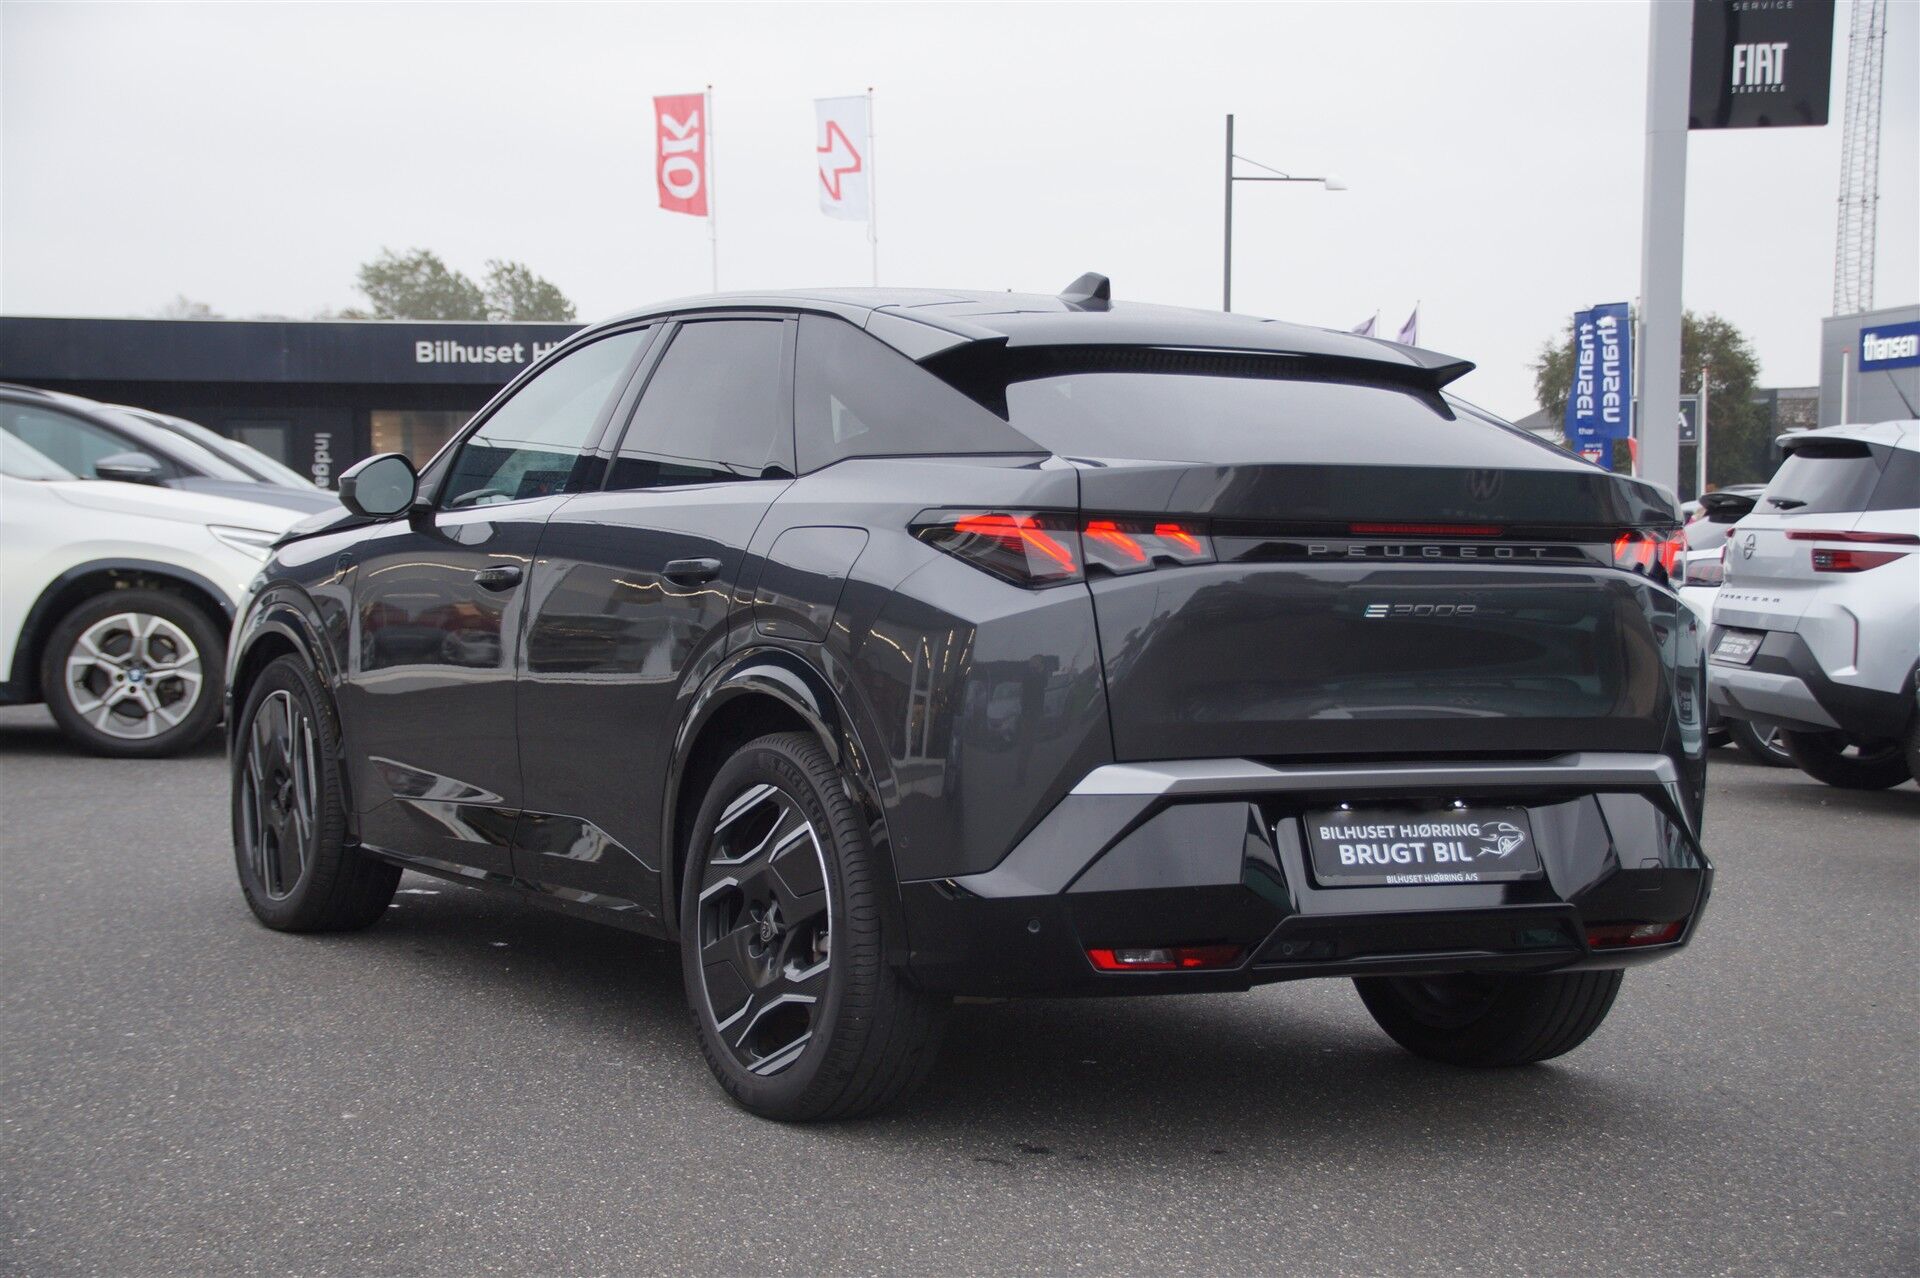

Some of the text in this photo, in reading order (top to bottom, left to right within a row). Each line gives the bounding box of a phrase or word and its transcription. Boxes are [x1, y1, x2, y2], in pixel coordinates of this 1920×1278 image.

[1733, 0, 1794, 11] SERVICE
[1732, 43, 1789, 86] FIAT
[661, 110, 700, 200] OK
[415, 341, 524, 363] Bilhuset
[1863, 333, 1918, 361] thansen
[1307, 544, 1547, 558] PEUGEOT
[1319, 823, 1481, 841] BILHUSET HJØRRING
[1338, 841, 1474, 866] BRUGT BIL
[1385, 872, 1479, 885] BILHUSET HJØRRING A/S
